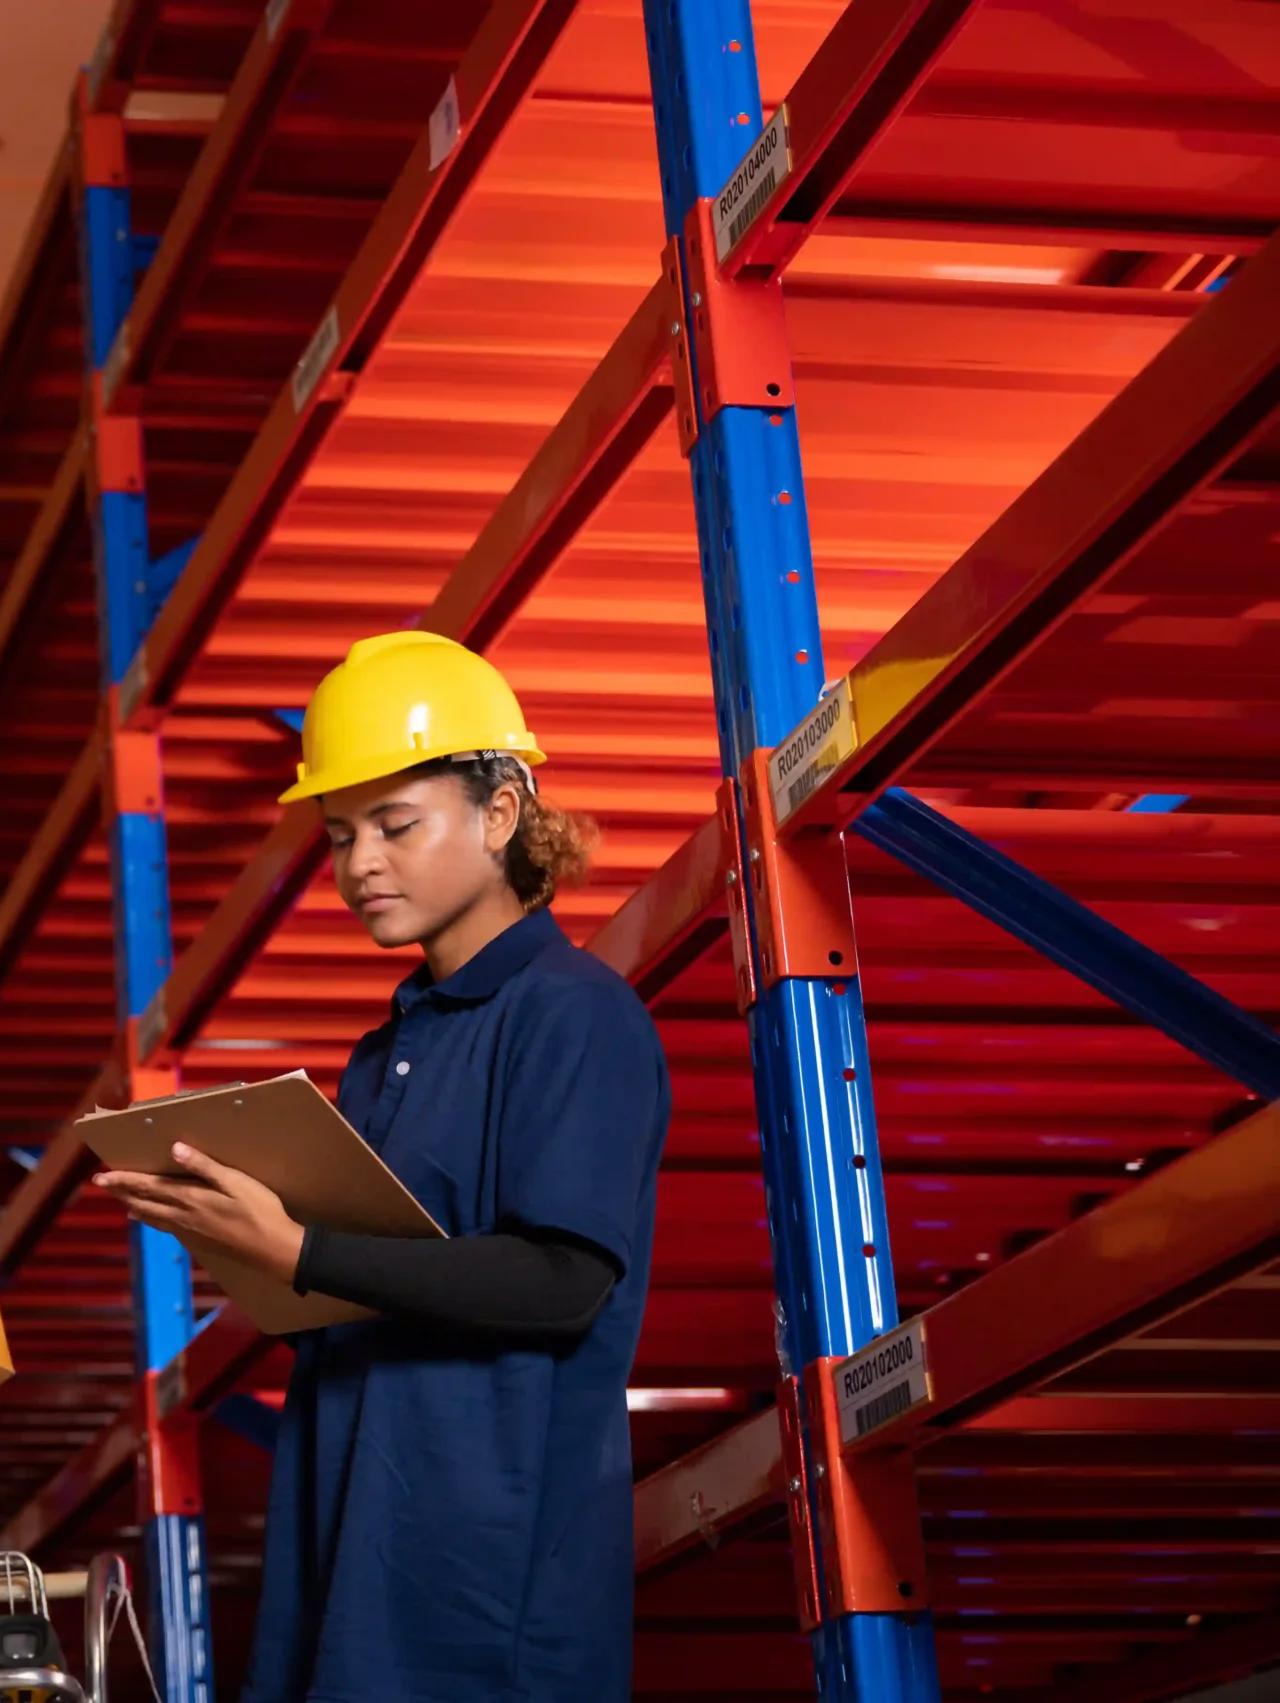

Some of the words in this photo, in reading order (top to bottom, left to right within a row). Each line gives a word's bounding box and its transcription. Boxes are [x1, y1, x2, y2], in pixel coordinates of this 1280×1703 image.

[719, 126, 778, 222] R020104000
[777, 698, 841, 781] R020103000
[844, 1335, 913, 1398] R020102000
